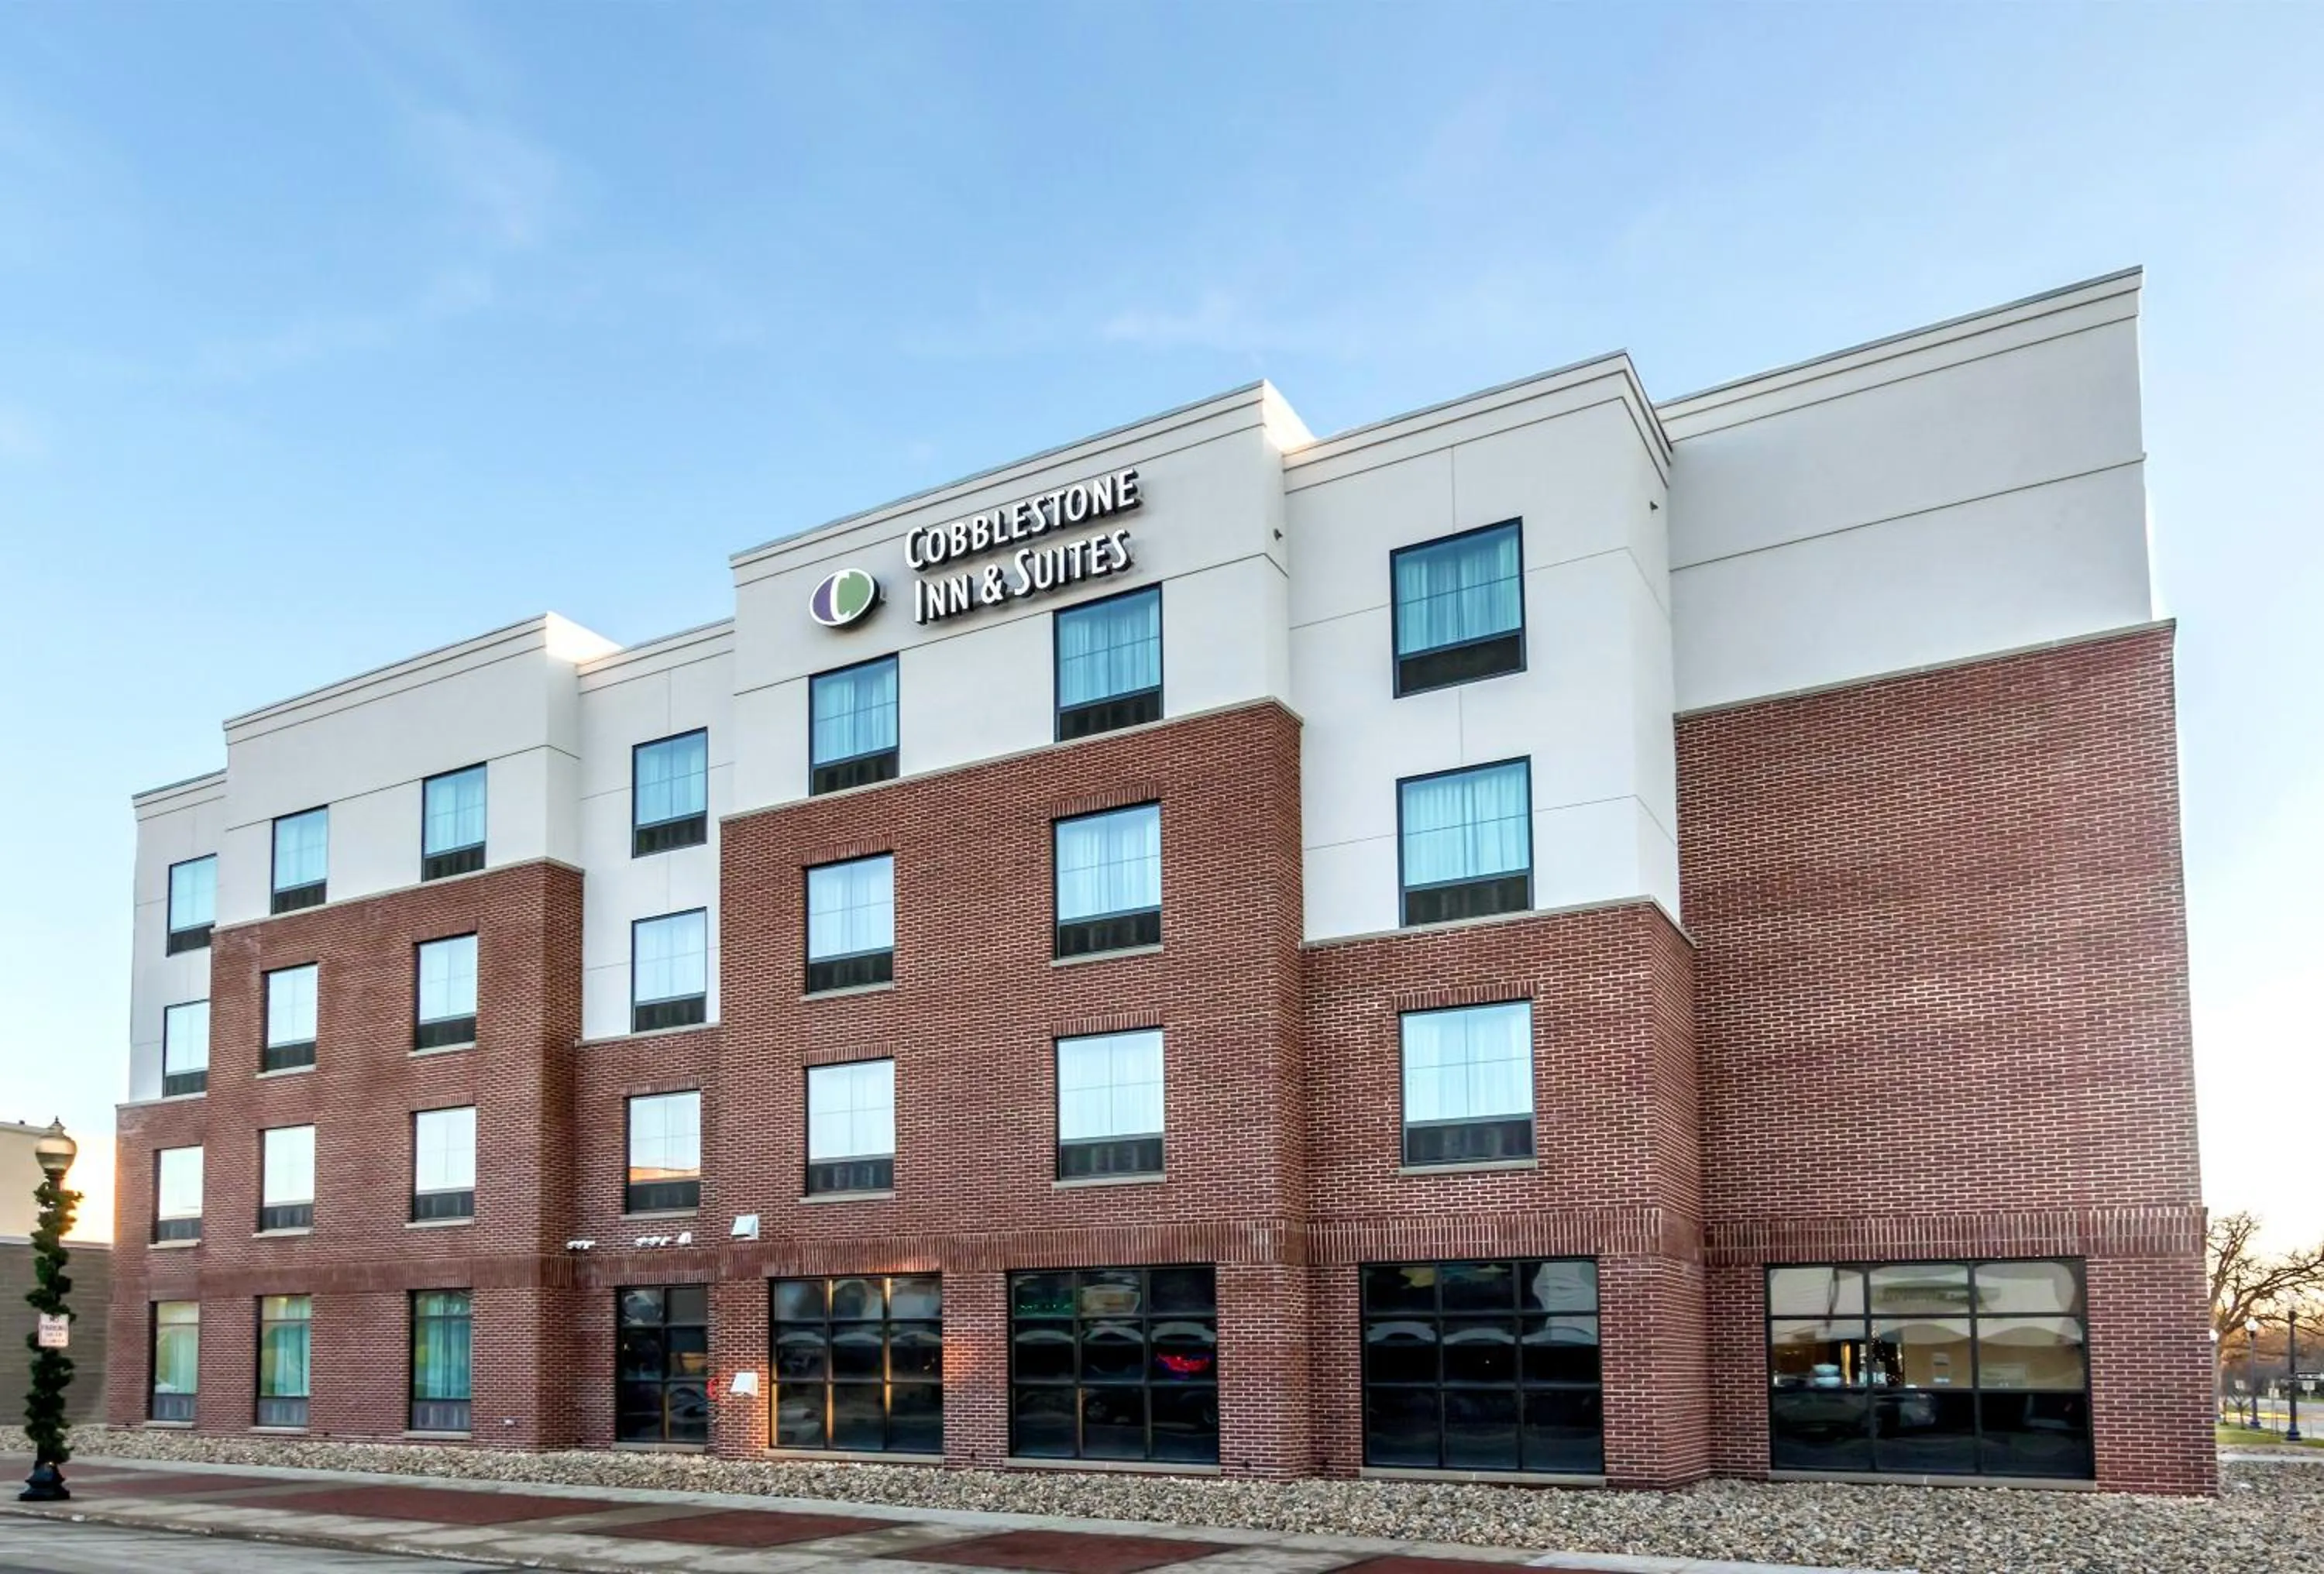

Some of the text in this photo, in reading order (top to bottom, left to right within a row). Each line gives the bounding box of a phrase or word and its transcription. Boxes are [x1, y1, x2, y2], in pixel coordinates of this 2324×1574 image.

[904, 469, 1136, 569] COBBLESTONE
[915, 529, 1129, 622] INN & SUITES
